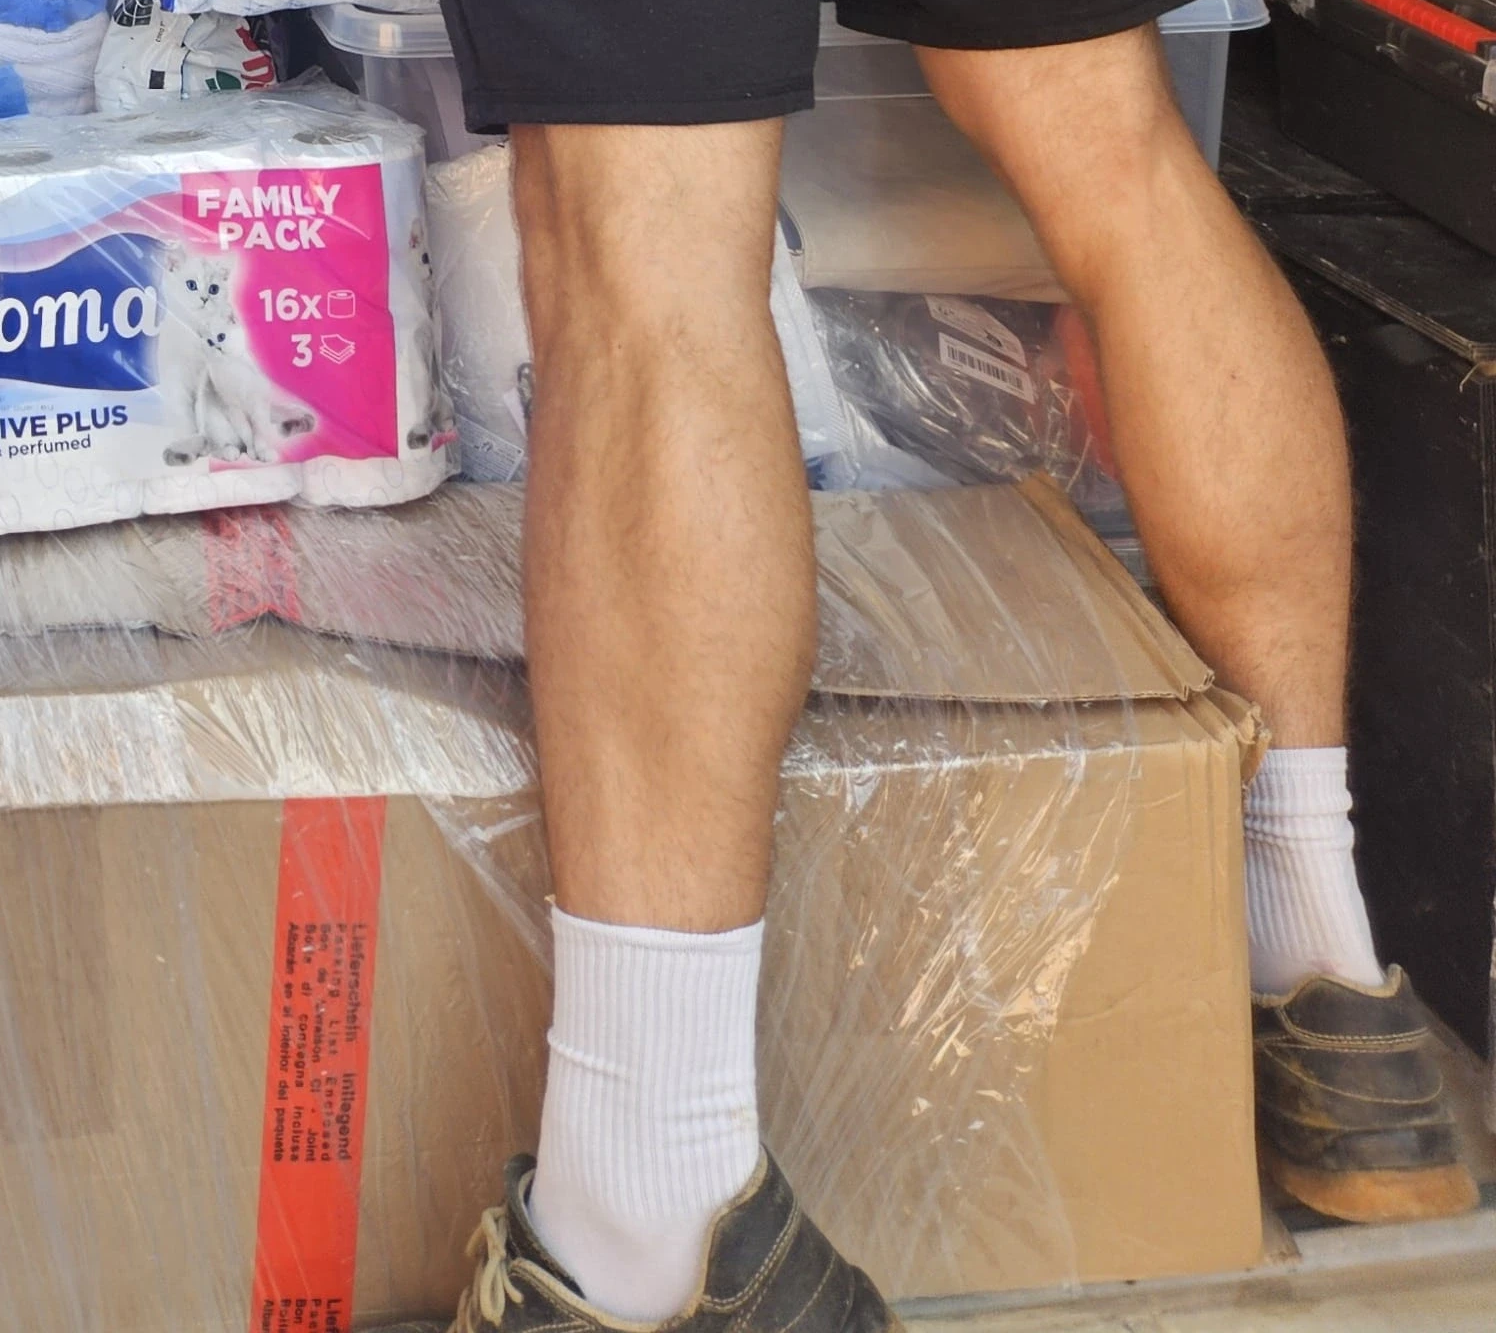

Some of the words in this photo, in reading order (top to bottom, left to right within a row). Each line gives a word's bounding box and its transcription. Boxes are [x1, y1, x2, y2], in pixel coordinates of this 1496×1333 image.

[196, 184, 341, 218] FAMILY
[219, 221, 326, 252] PACK
[258, 288, 323, 323] 16x
[291, 335, 313, 367] 3
[56, 405, 129, 435] PLUS
[8, 434, 92, 459] perfumed
[328, 1020, 341, 1055] List
[320, 1076, 338, 1162] Enclosed
